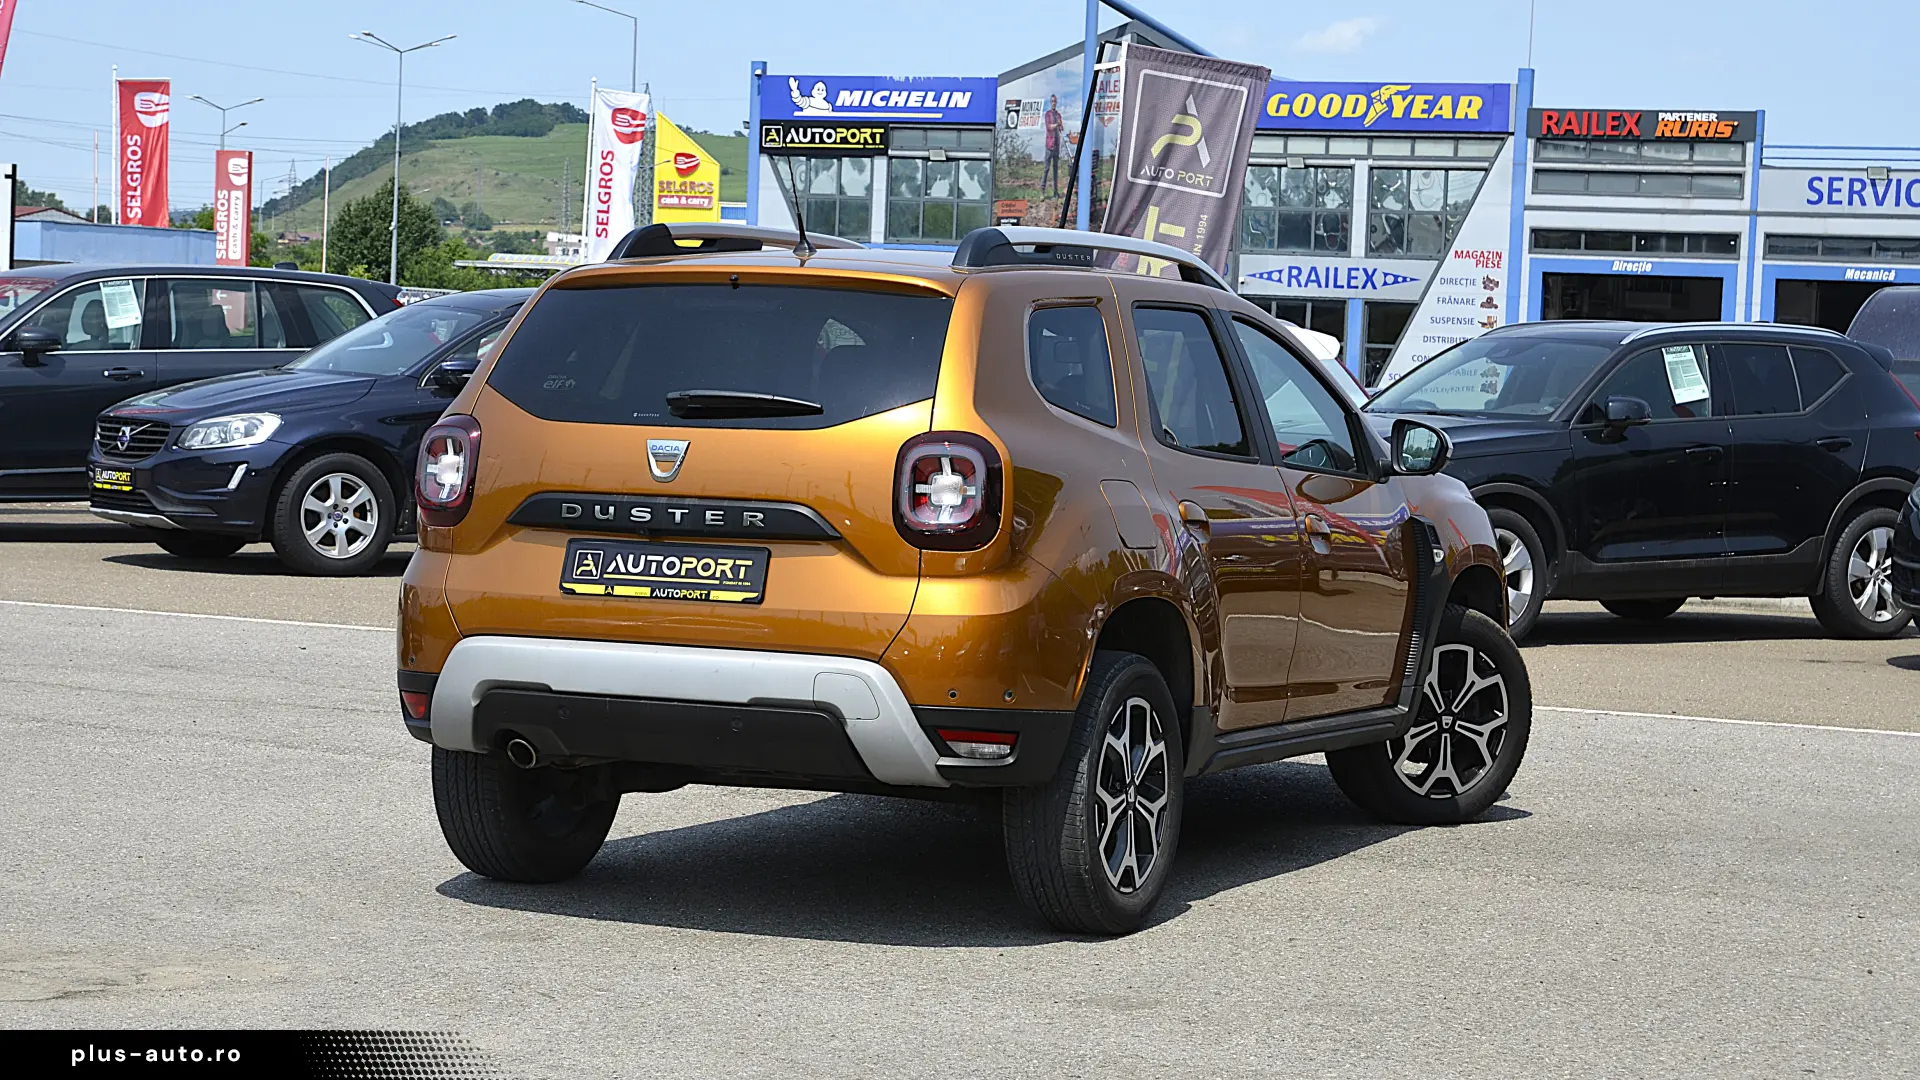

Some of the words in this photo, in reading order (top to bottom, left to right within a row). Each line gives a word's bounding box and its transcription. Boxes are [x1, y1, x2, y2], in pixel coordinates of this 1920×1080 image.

[835, 90, 972, 108] MICHELIN
[1541, 111, 1641, 136] RAILEX
[1658, 112, 1718, 122] PARTENER
[786, 127, 885, 143] AUTOPORT
[1654, 121, 1738, 138] RURIS
[126, 134, 142, 219] SELGROS
[1140, 164, 1175, 180] AUTO
[1177, 170, 1214, 187] PORT
[596, 150, 615, 238] SELGROS
[658, 180, 714, 194] SELGROS
[660, 195, 679, 204] cash
[687, 198, 710, 207] carry
[215, 189, 229, 260] SELGROS
[1196, 214, 1208, 240] 1994
[1056, 253, 1091, 261] DUSTER
[1454, 250, 1503, 260] MAGAZIN
[1475, 259, 1502, 269] PIESE
[1286, 266, 1378, 290] RAILEX
[1844, 268, 1896, 281] Mecanică
[1430, 316, 1476, 326] SUSPENSIE
[543, 379, 565, 389] elf
[651, 444, 681, 452] DACIA
[102, 470, 131, 481] AUTOPORT
[561, 503, 765, 527] DUSTER
[606, 553, 753, 580] AUTOPORT
[652, 588, 708, 600] AUTOPORT
